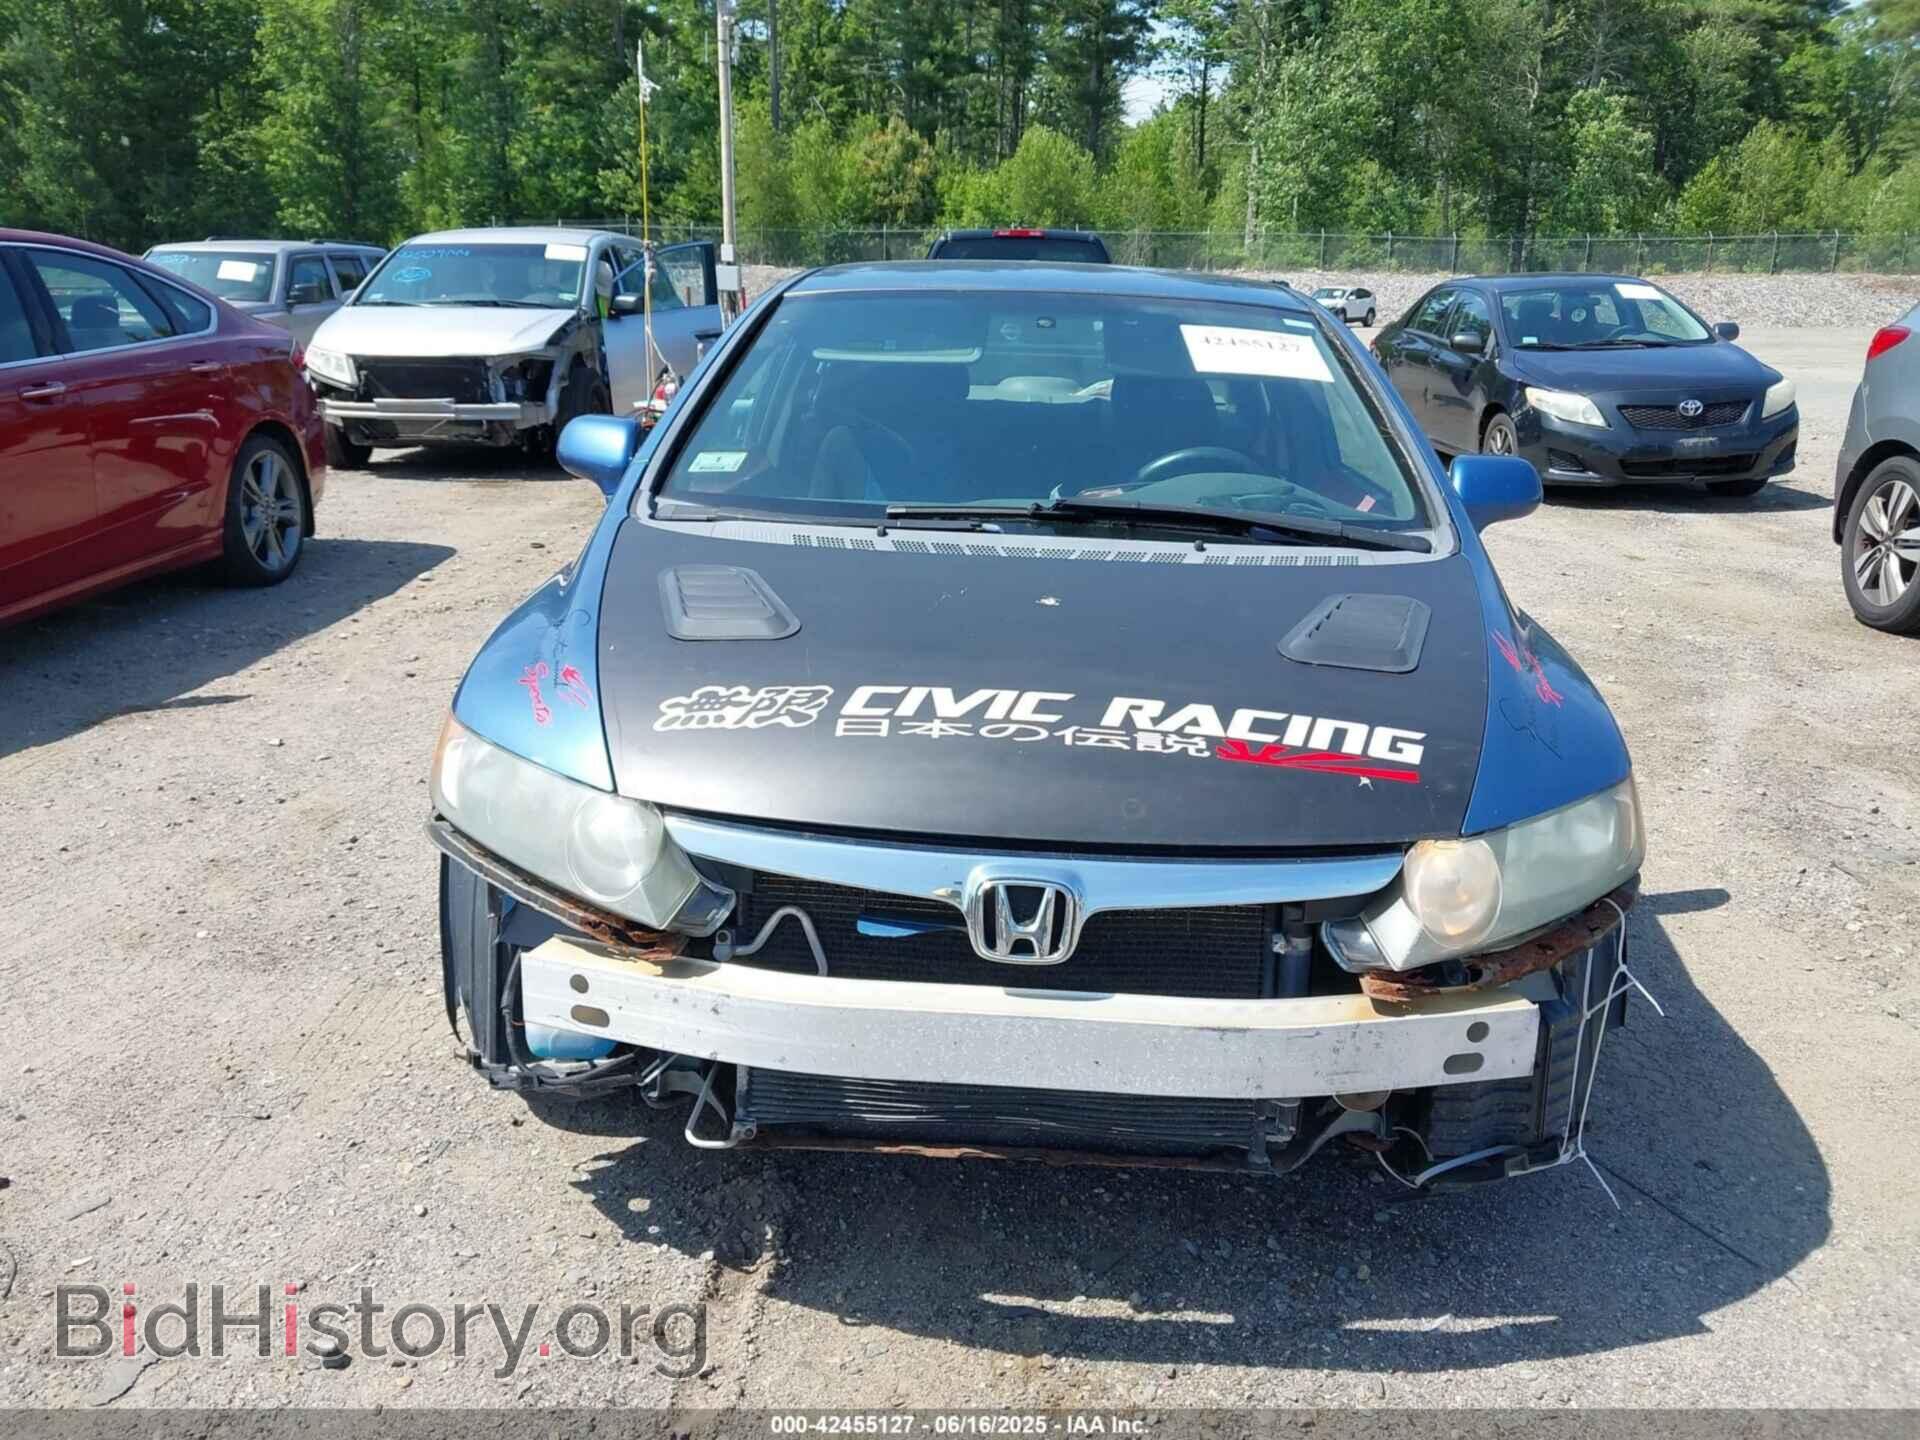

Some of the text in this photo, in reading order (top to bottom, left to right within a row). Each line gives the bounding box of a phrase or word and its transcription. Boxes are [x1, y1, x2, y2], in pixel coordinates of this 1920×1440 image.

[834, 718, 1211, 758] 日本の伝説
[838, 685, 1428, 766] CIVIC RACING
